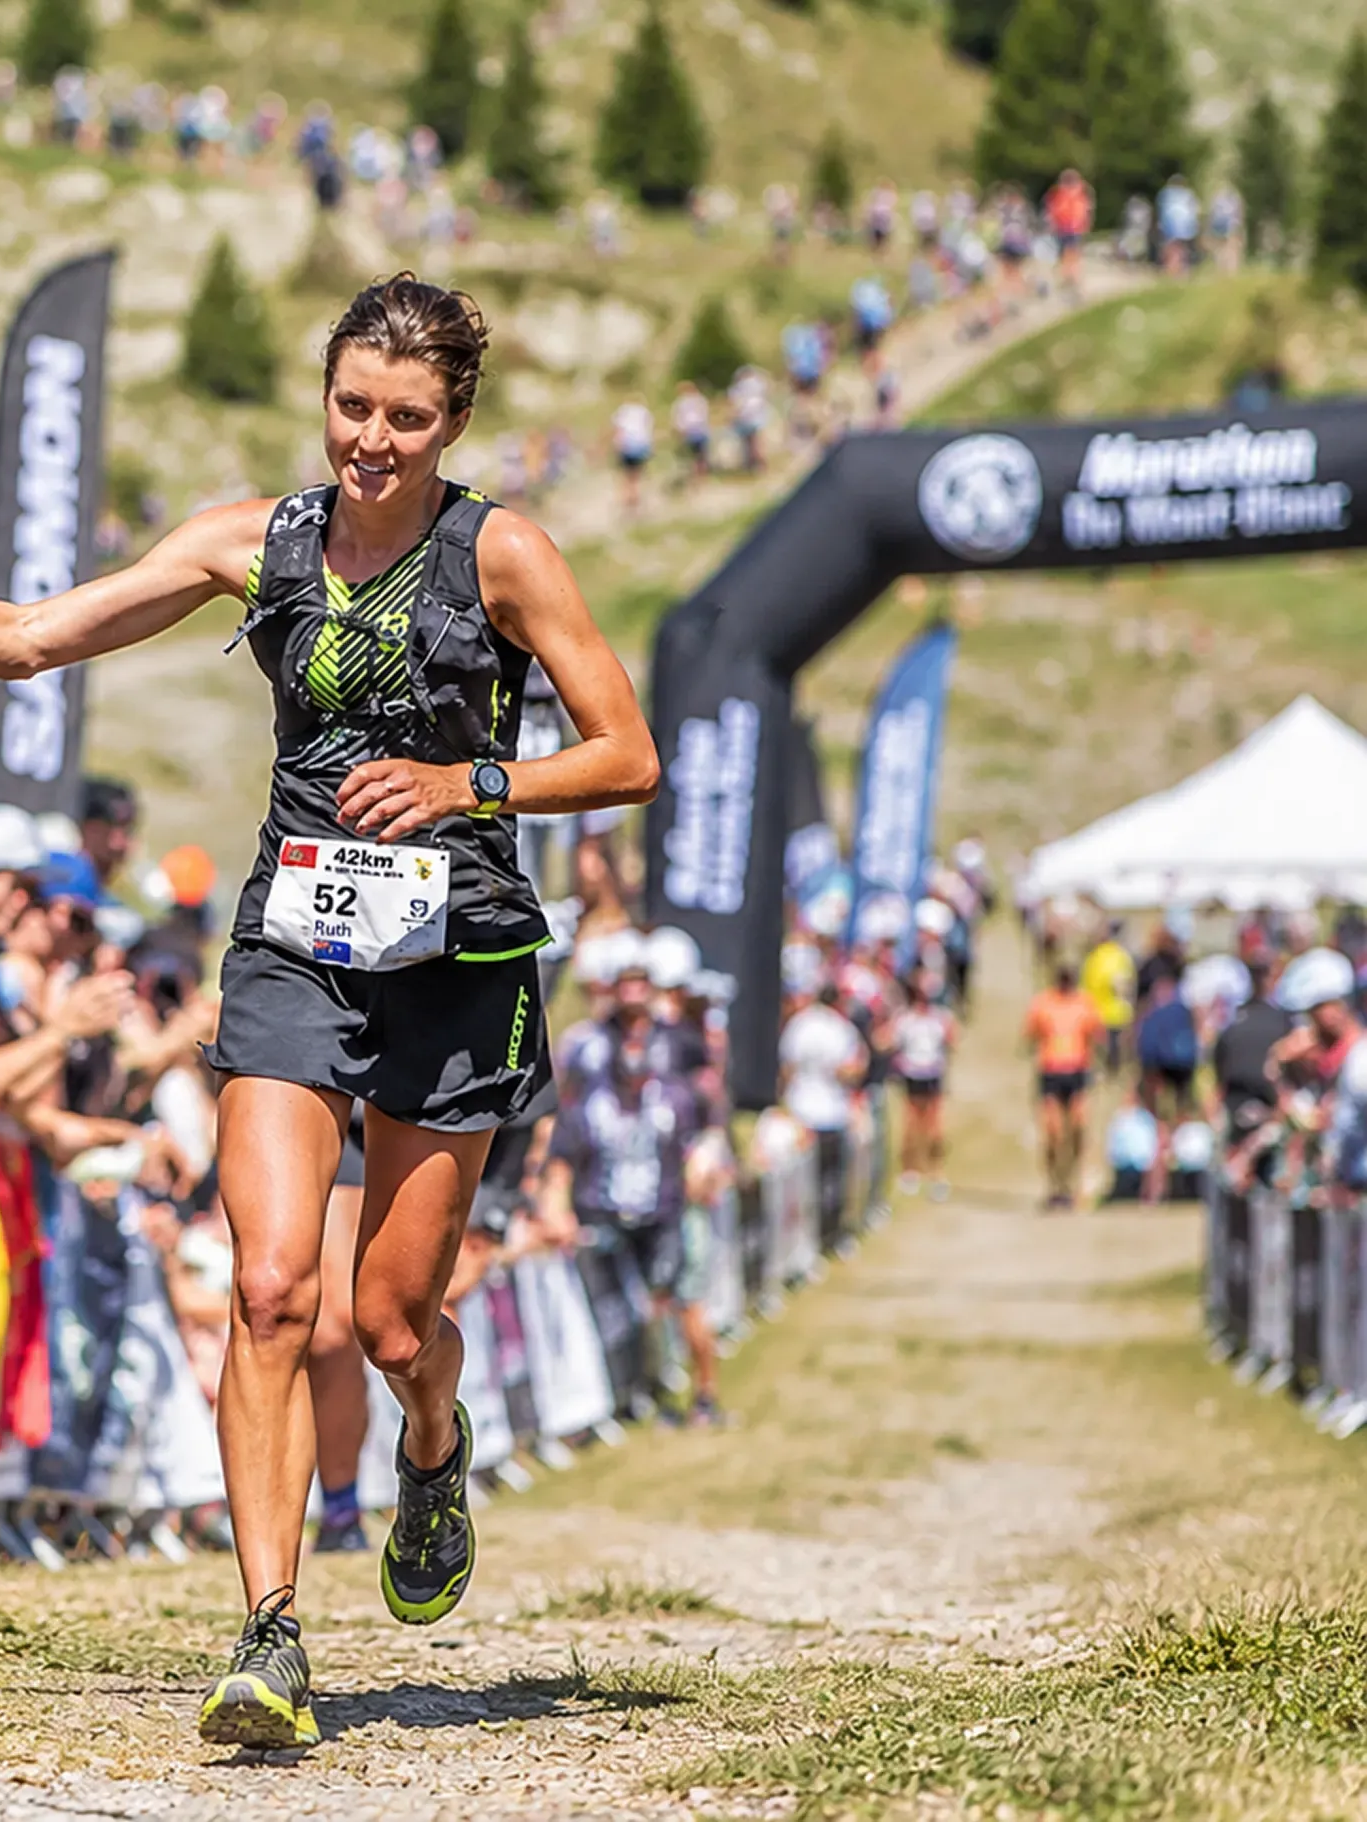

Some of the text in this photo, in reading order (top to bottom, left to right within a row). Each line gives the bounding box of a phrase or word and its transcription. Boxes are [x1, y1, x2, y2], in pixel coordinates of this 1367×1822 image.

[1, 334, 86, 781] SAOMON
[333, 847, 394, 869] 42km
[313, 883, 358, 918] 52
[313, 919, 352, 937] Ruth
